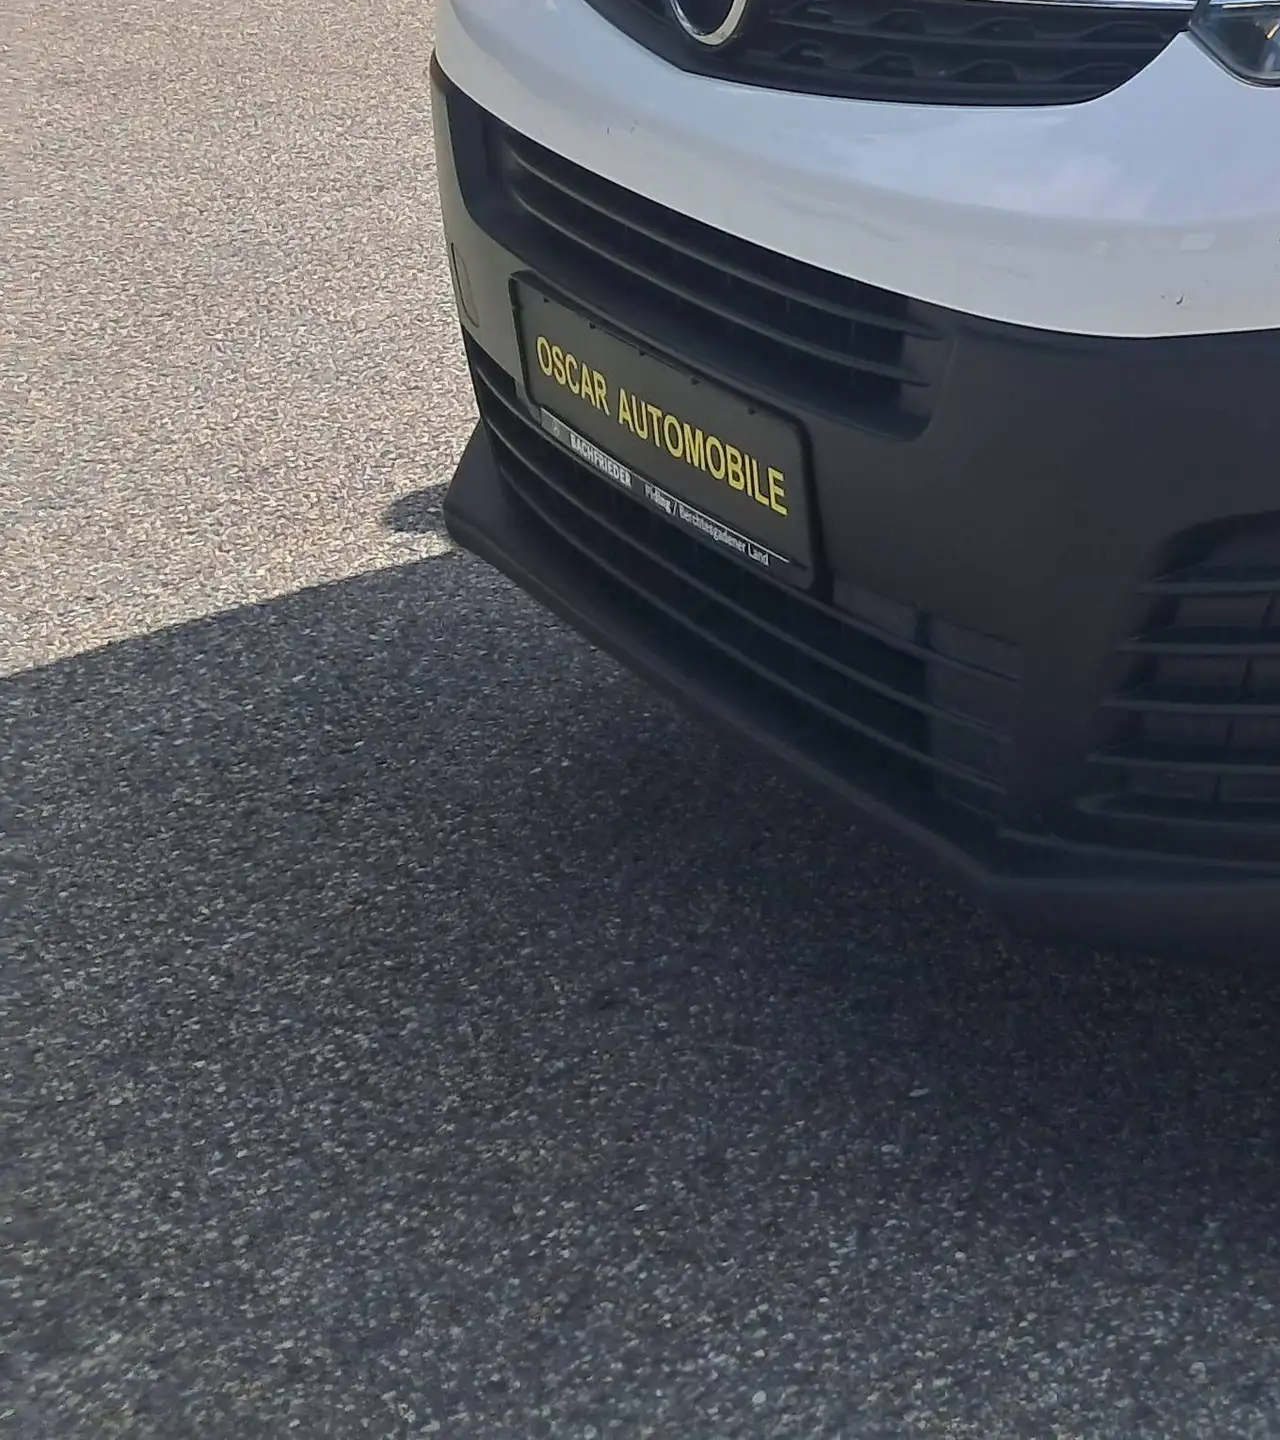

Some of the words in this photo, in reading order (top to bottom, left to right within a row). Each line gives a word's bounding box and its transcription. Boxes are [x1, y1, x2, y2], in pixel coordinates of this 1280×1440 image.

[536, 336, 611, 416] OSCAR
[618, 387, 788, 516] AUTOMOBILE
[570, 433, 632, 489] BACHFRIEDER
[748, 542, 770, 566] Land
